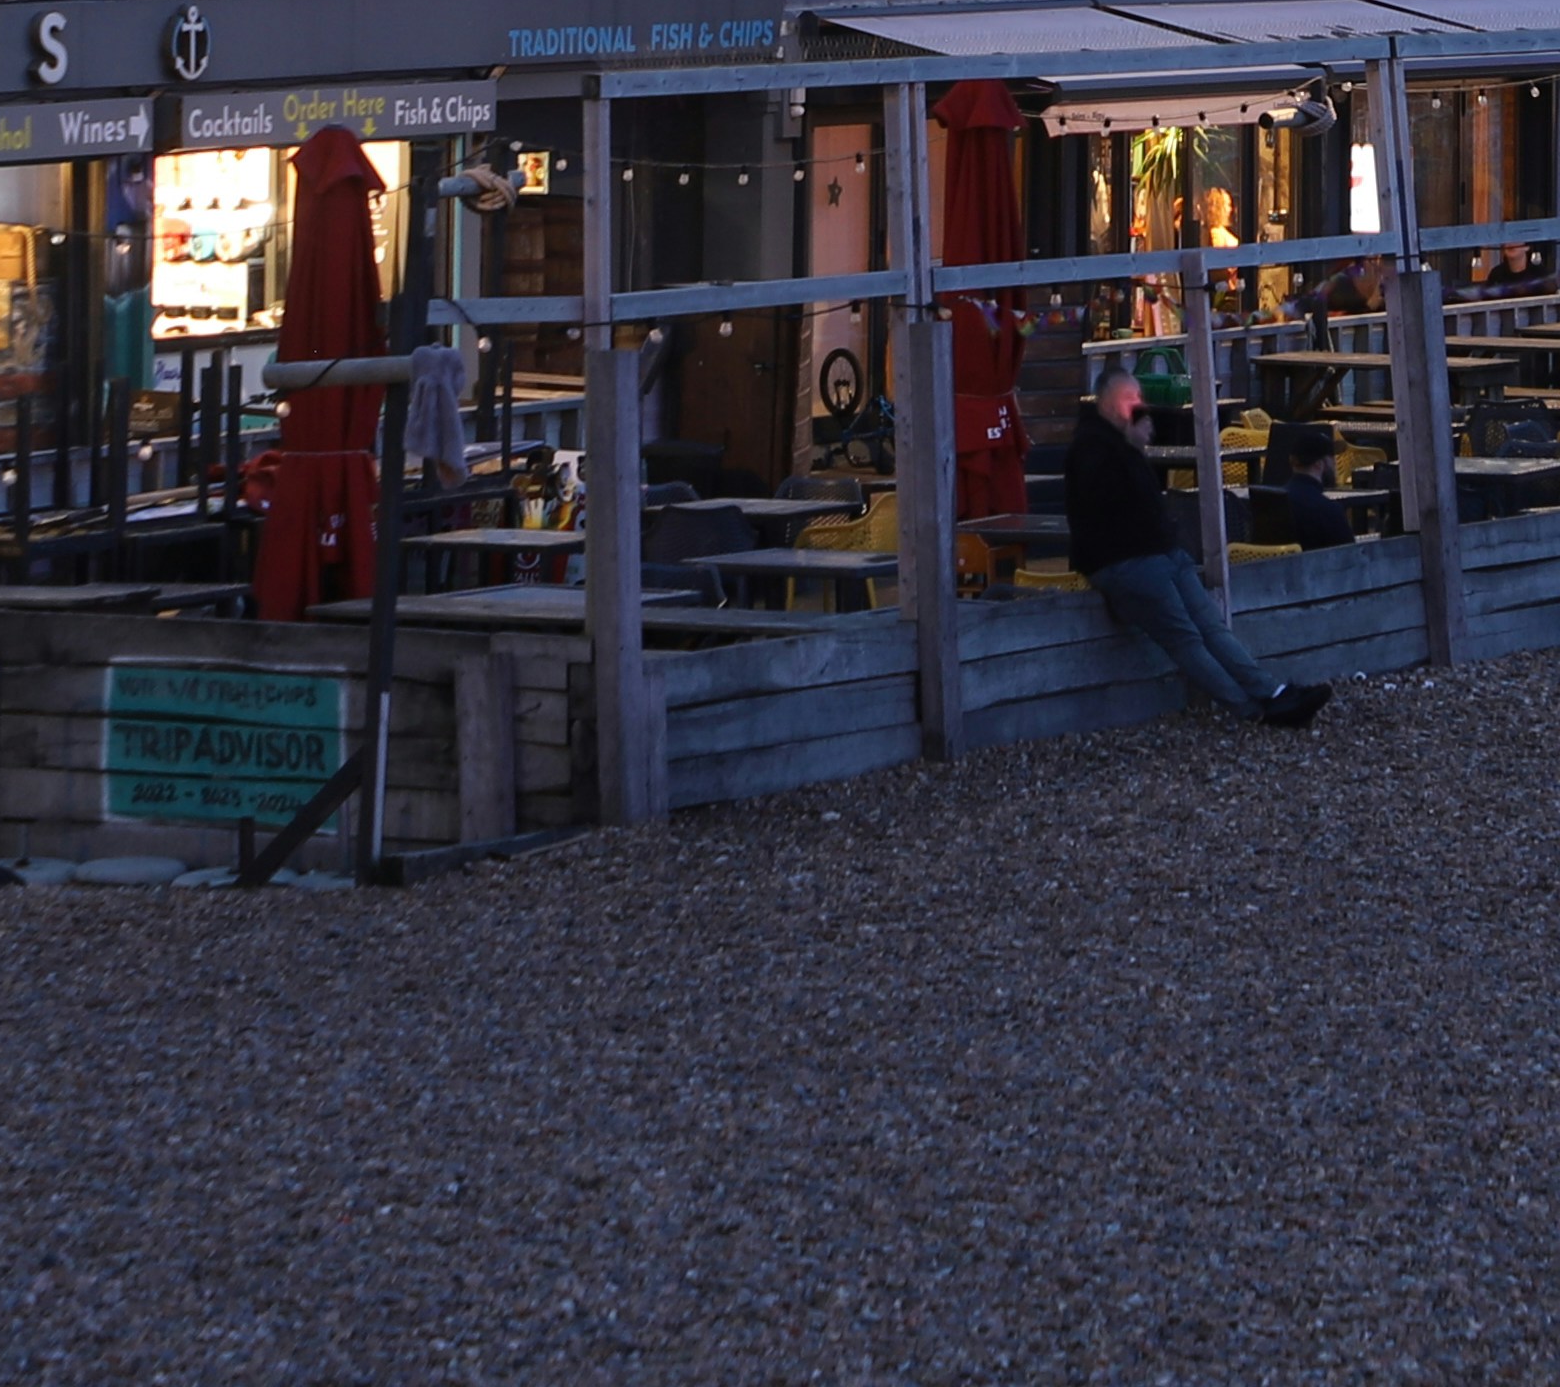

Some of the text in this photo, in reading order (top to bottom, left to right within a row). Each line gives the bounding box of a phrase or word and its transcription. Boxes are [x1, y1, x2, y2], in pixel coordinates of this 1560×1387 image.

[508, 19, 774, 57] TRADITIONAL FISH & CHIPS
[59, 112, 127, 145] Wines
[189, 89, 491, 138] Cocktails Order Here Fish & Chips
[114, 722, 326, 773] TRIPADVISOR
